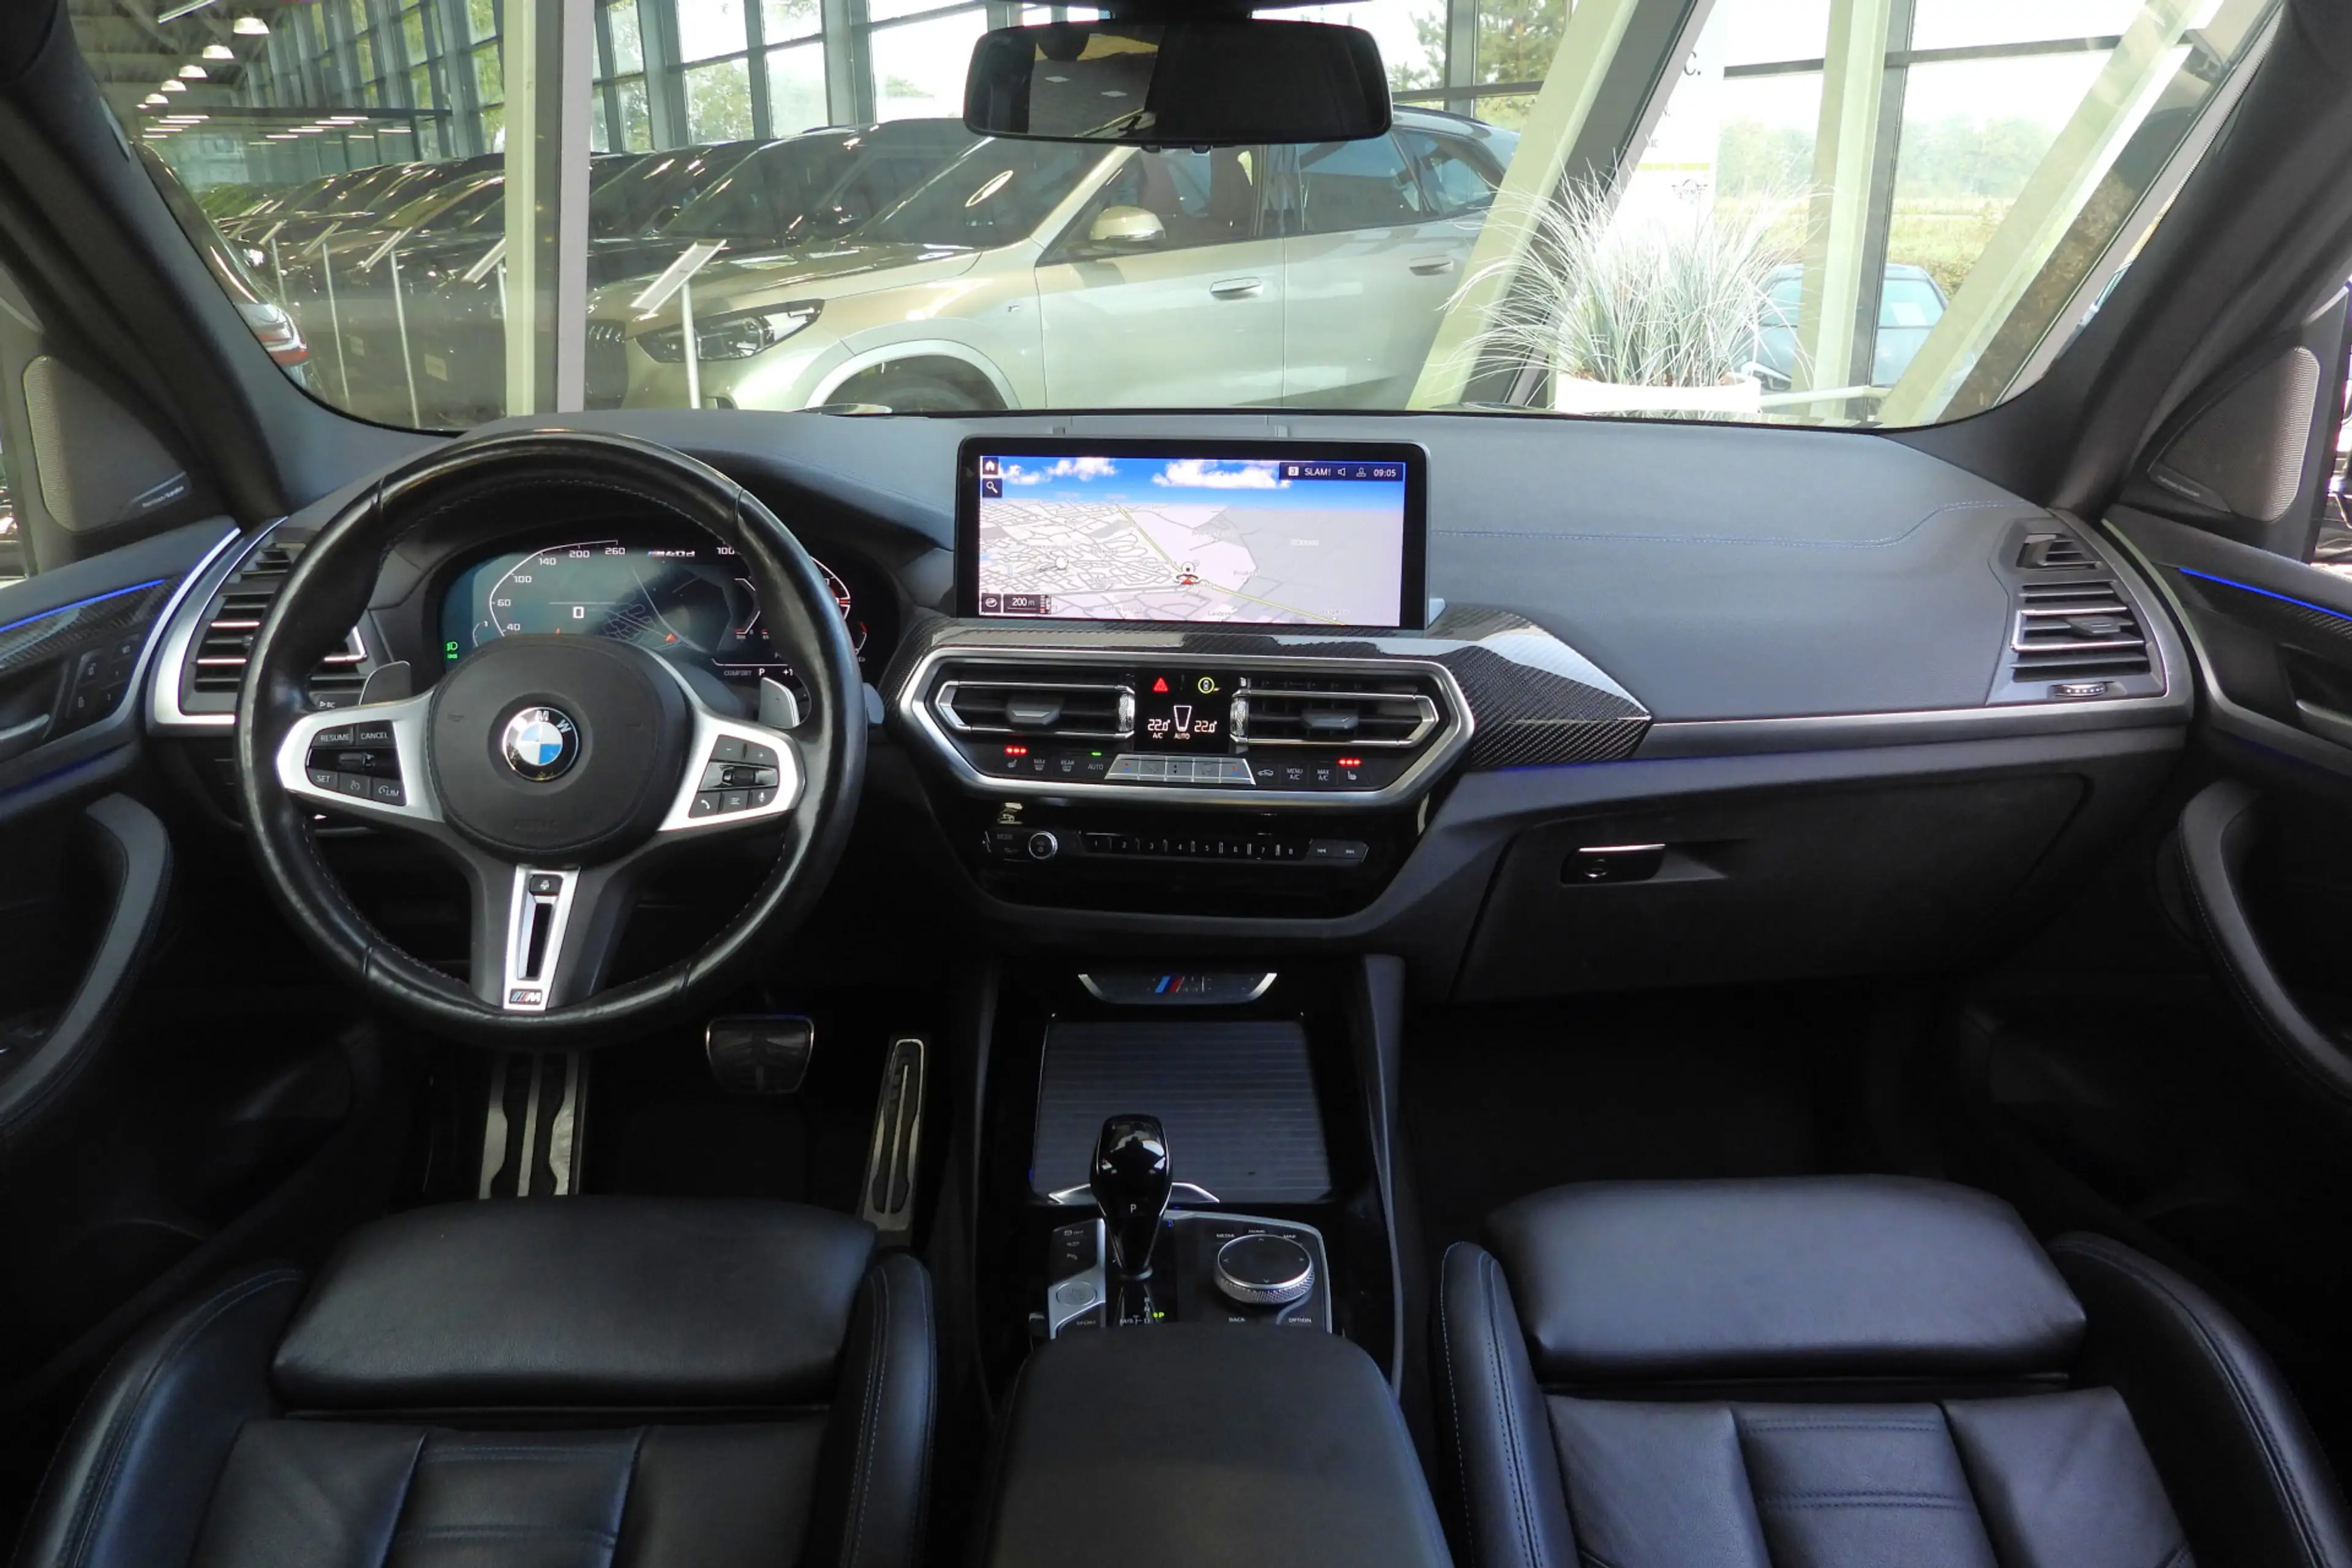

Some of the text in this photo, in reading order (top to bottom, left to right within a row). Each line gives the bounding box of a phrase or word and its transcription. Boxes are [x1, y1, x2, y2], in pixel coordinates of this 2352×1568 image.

[1304, 468, 1331, 477] SLAM!
[1373, 469, 1396, 477] 09:05
[605, 547, 626, 556] 260
[1012, 597, 1027, 606] 200
[573, 606, 584, 619] 0
[759, 668, 765, 676] P
[360, 731, 388, 740] CANCEL
[317, 775, 331, 783] SET
[1130, 1204, 1137, 1213] P
